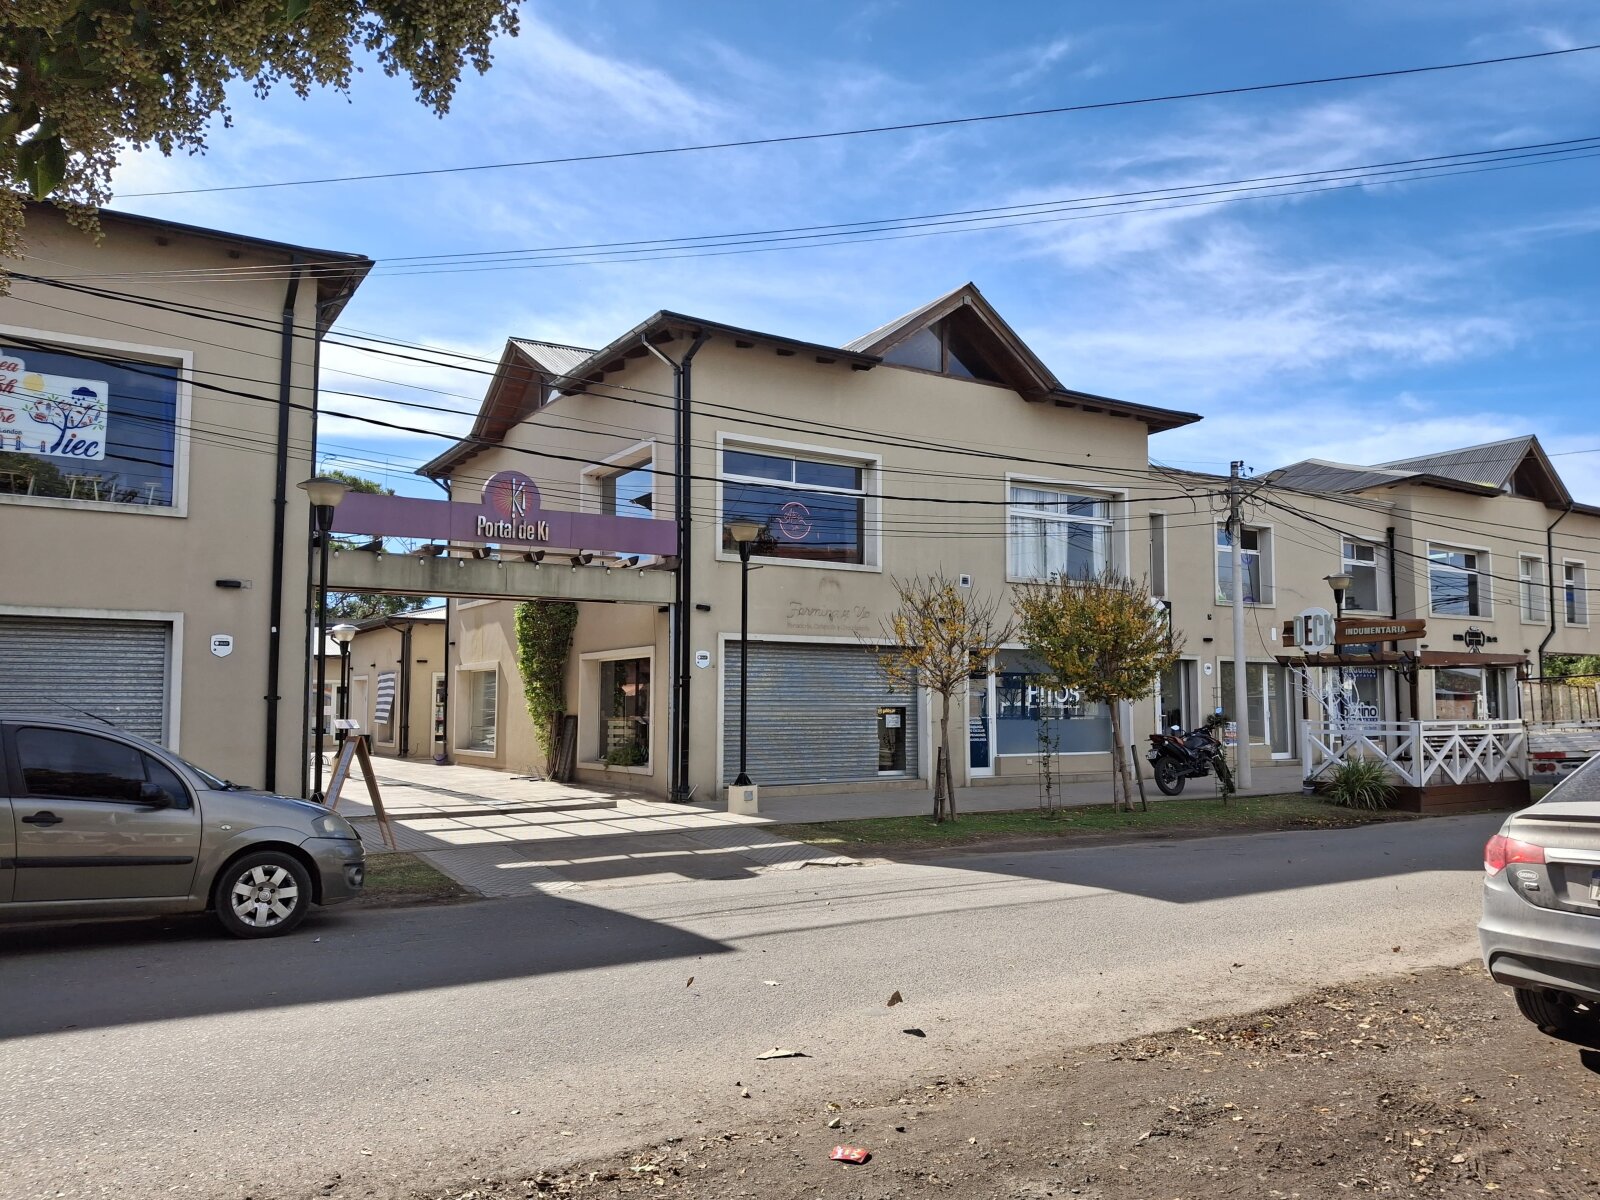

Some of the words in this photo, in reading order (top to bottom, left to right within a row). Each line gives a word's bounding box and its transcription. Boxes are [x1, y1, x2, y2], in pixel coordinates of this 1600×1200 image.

[476, 515, 516, 539] Portal
[518, 521, 535, 540] de
[537, 520, 550, 541] Ki
[1293, 614, 1336, 646] DECK
[1345, 625, 1407, 636] INDUMENTARIA
